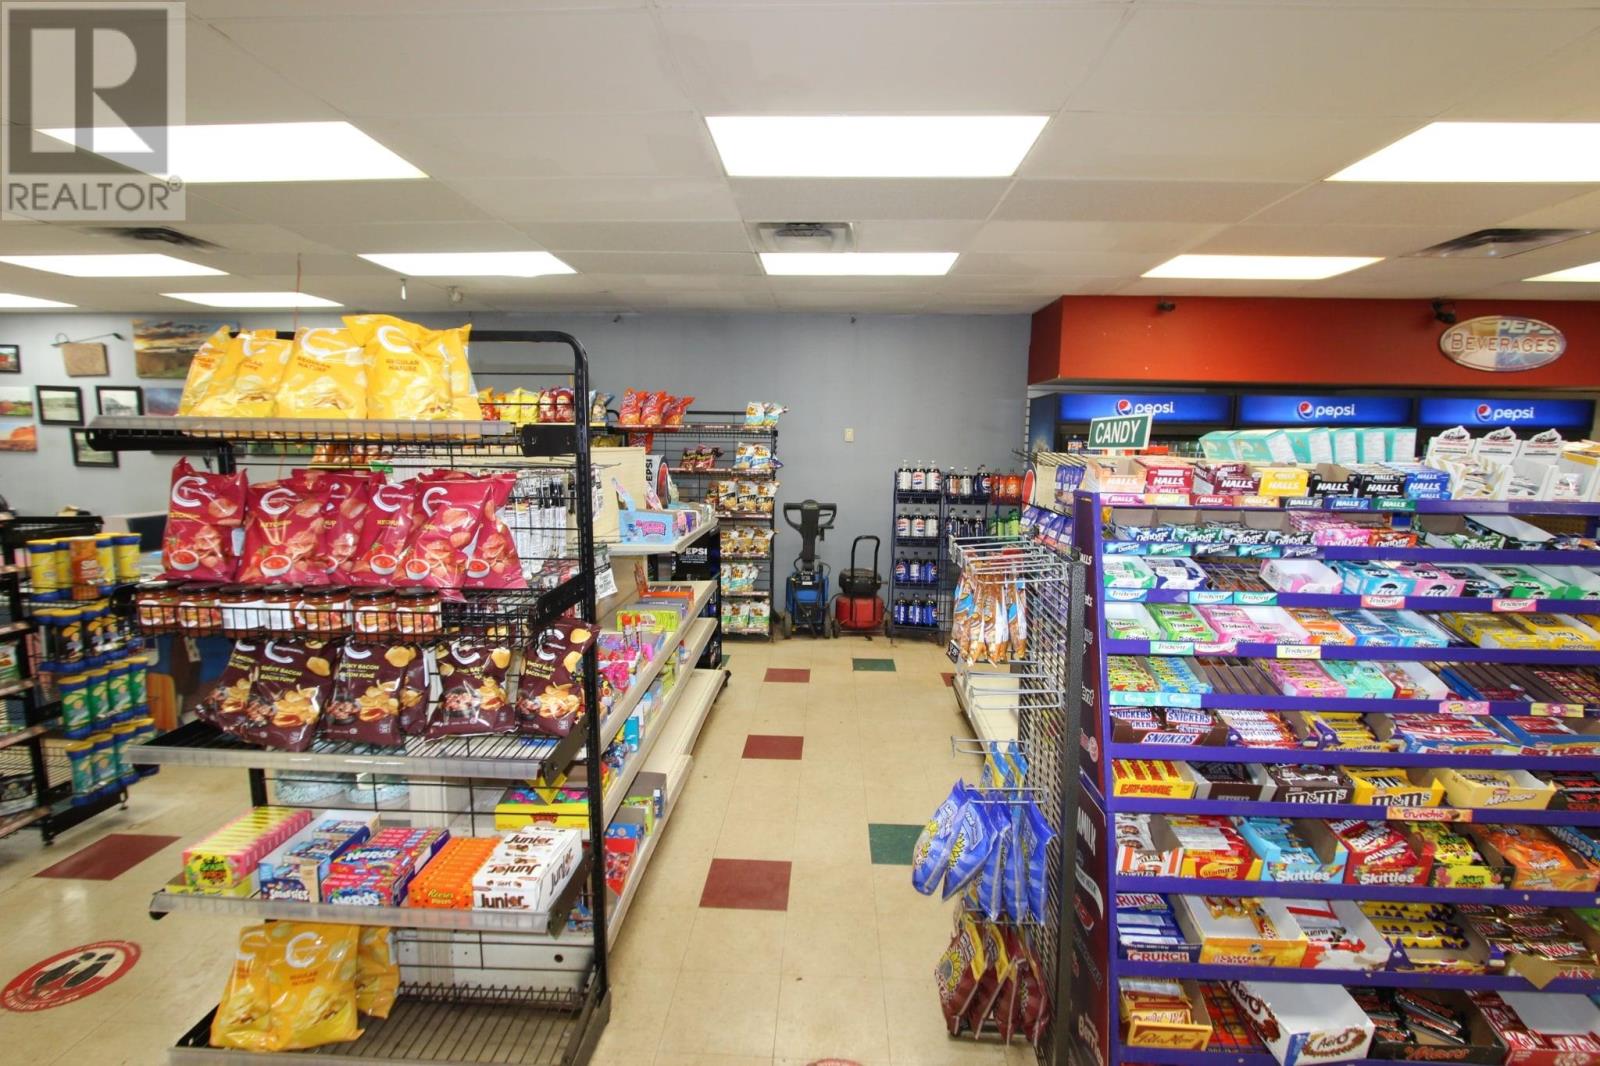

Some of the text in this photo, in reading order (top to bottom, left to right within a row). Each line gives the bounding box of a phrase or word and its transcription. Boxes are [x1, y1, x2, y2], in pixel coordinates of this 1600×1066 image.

[1451, 332, 1558, 353] BEVERAGES
[1134, 401, 1175, 416] pepsi
[1315, 403, 1356, 418] pepsi
[1492, 407, 1535, 421] pepsi
[1095, 420, 1142, 445] CANDY
[1154, 477, 1185, 486] HALLS
[1222, 480, 1253, 489] HALLS
[1317, 483, 1349, 491] HALLS
[1409, 482, 1440, 490] HALLS
[1367, 484, 1399, 492] HALLS
[685, 547, 708, 556] EPSI
[1079, 553, 1093, 566] ALLS
[1112, 710, 1151, 719] SNICKERS
[1168, 712, 1211, 724] SNICKERS
[1144, 733, 1196, 744] SNICKERS
[1403, 809, 1444, 819] Crunchie
[1276, 870, 1331, 882] Skittles
[1360, 872, 1415, 885] Skittles
[1116, 893, 1162, 908] RUNCH
[1129, 951, 1189, 961] CRUNCH
[1316, 1030, 1350, 1050] Aero
